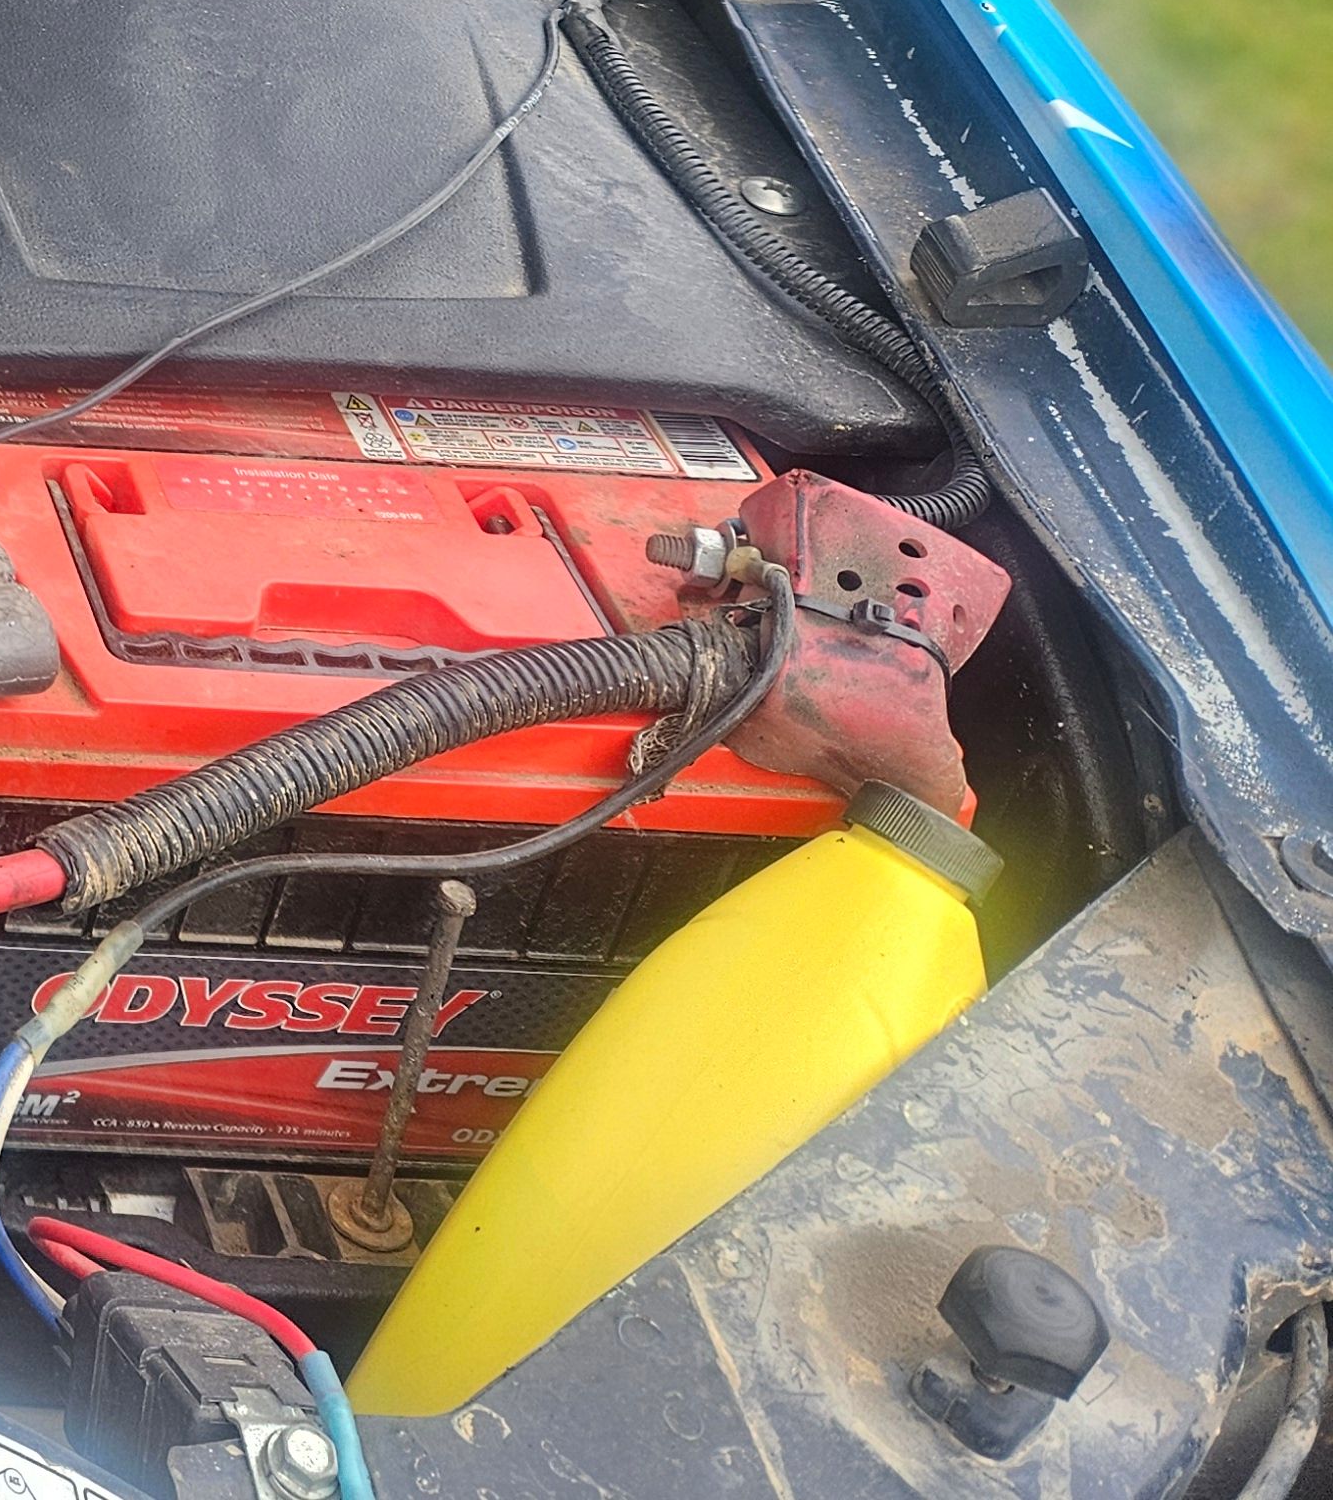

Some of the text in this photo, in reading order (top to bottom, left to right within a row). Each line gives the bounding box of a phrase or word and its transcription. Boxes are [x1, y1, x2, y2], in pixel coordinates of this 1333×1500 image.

[429, 398, 619, 418] DANGER/POISON
[234, 466, 340, 482] Installation Date
[315, 1058, 543, 1098] Extre
[92, 1116, 118, 1128] CCA
[162, 1120, 212, 1132] Reserve
[212, 1122, 266, 1136] Capacity
[276, 1124, 300, 1136] 135
[302, 1126, 352, 1139] minutes
